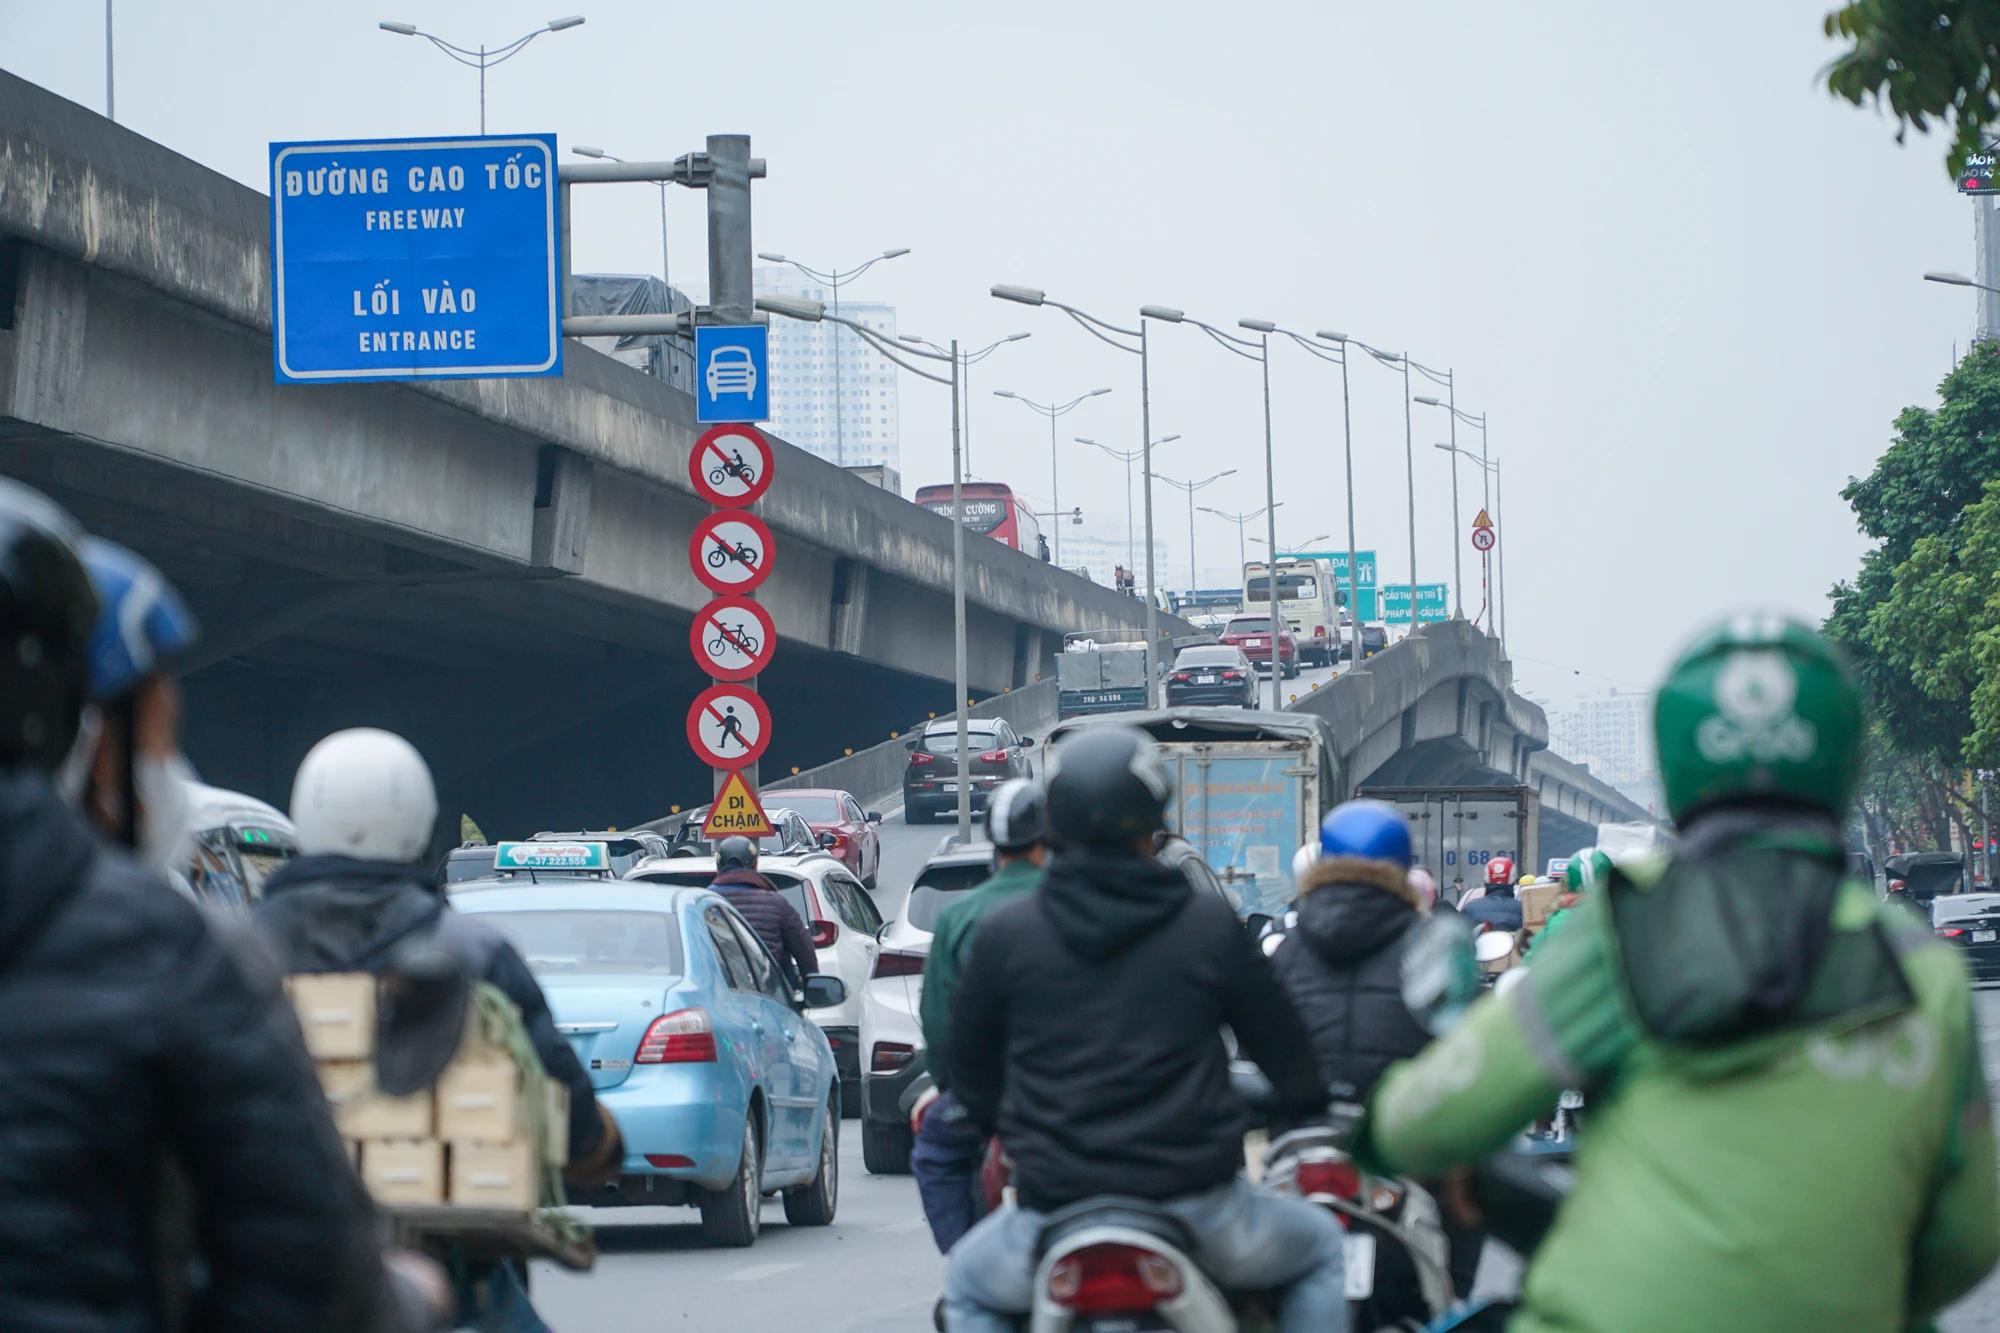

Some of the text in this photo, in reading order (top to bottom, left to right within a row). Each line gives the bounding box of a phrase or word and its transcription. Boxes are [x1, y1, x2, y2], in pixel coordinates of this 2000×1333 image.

[286, 152, 542, 197] ĐƯỜNG CAO TỐC
[366, 207, 465, 231] FREEWAY
[353, 278, 476, 316] LỐI VÀO
[359, 329, 476, 353] ENTRANCE
[729, 796, 744, 809] ĐI
[712, 812, 760, 830] CHẬM
[535, 857, 587, 865] 37.222.555
[1468, 850, 1490, 865] 68
